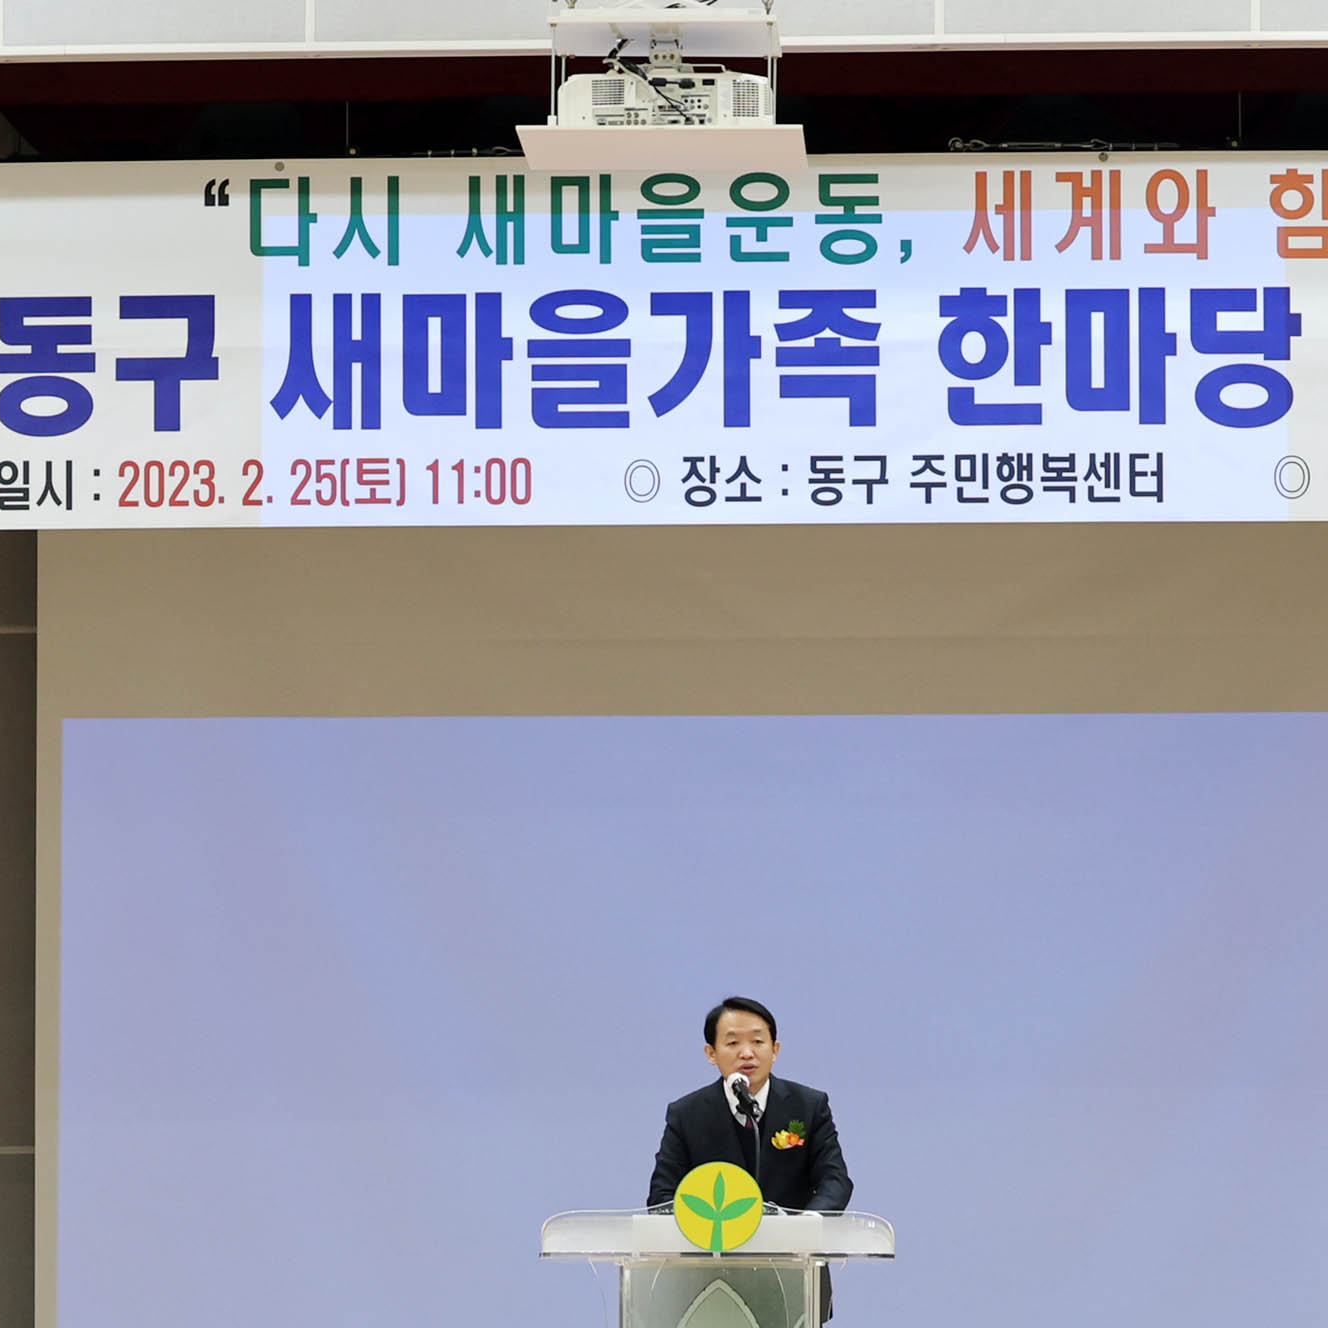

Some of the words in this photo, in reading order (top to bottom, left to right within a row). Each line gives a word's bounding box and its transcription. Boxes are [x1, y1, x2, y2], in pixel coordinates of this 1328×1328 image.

[456, 171, 913, 266] 새마을운동,
[962, 168, 1216, 262] 세계와
[270, 288, 882, 430] 새마을가족
[937, 286, 1302, 429] 한마당
[117, 459, 226, 508] 2023.
[242, 459, 273, 506] 2.
[290, 457, 406, 507] 25(토)
[426, 457, 532, 505] 11:00
[681, 455, 763, 507] 장소
[808, 454, 889, 506] 동구
[909, 452, 1165, 505] 주민행복센터
